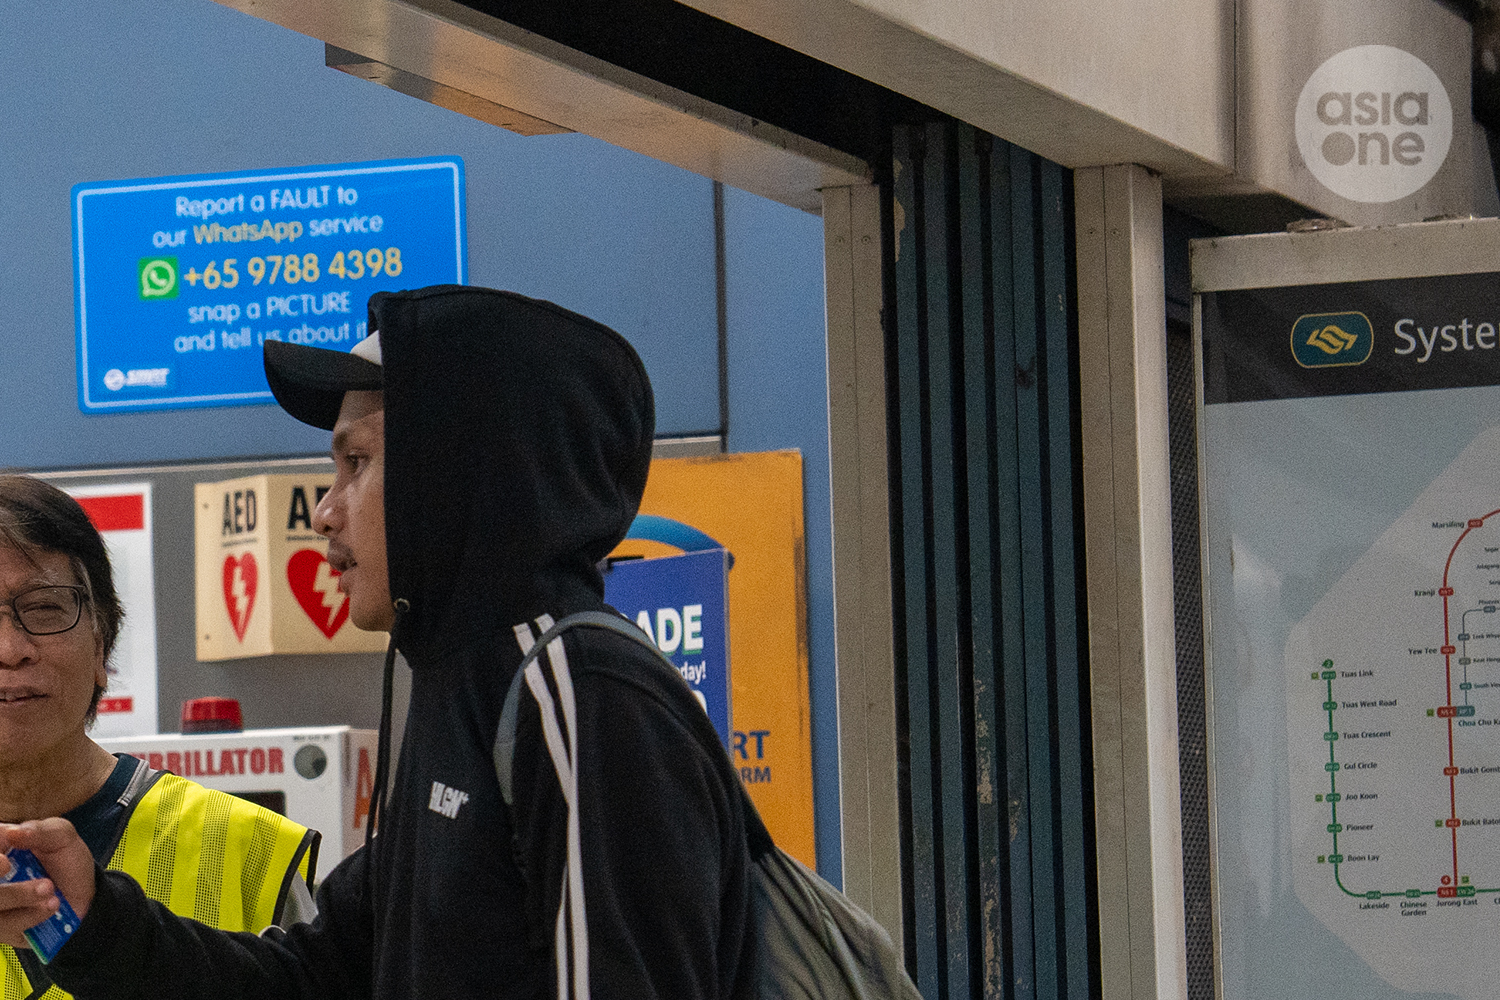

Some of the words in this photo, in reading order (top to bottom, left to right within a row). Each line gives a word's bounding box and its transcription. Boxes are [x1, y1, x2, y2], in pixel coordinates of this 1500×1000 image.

[176, 193, 244, 220] Report
[250, 195, 265, 212] a
[270, 185, 330, 210] FAULT
[337, 186, 358, 205] to
[153, 228, 187, 248] our
[193, 219, 303, 244] WhatsApp
[309, 213, 383, 237] service
[184, 258, 239, 289] +65
[248, 253, 320, 286] 9788
[328, 247, 402, 280] 4398
[188, 304, 240, 325] snap
[246, 302, 261, 319] a
[266, 291, 350, 317] PICTURE
[174, 329, 215, 353] and
[222, 326, 251, 349] tell
[288, 322, 349, 345] about
[1395, 317, 1500, 363] Syste
[222, 489, 257, 536] AED
[634, 604, 704, 653] ADE
[678, 660, 706, 685] day!
[129, 747, 284, 777] BRILLATOR
[733, 730, 771, 760] RT
[737, 766, 771, 784] RM
